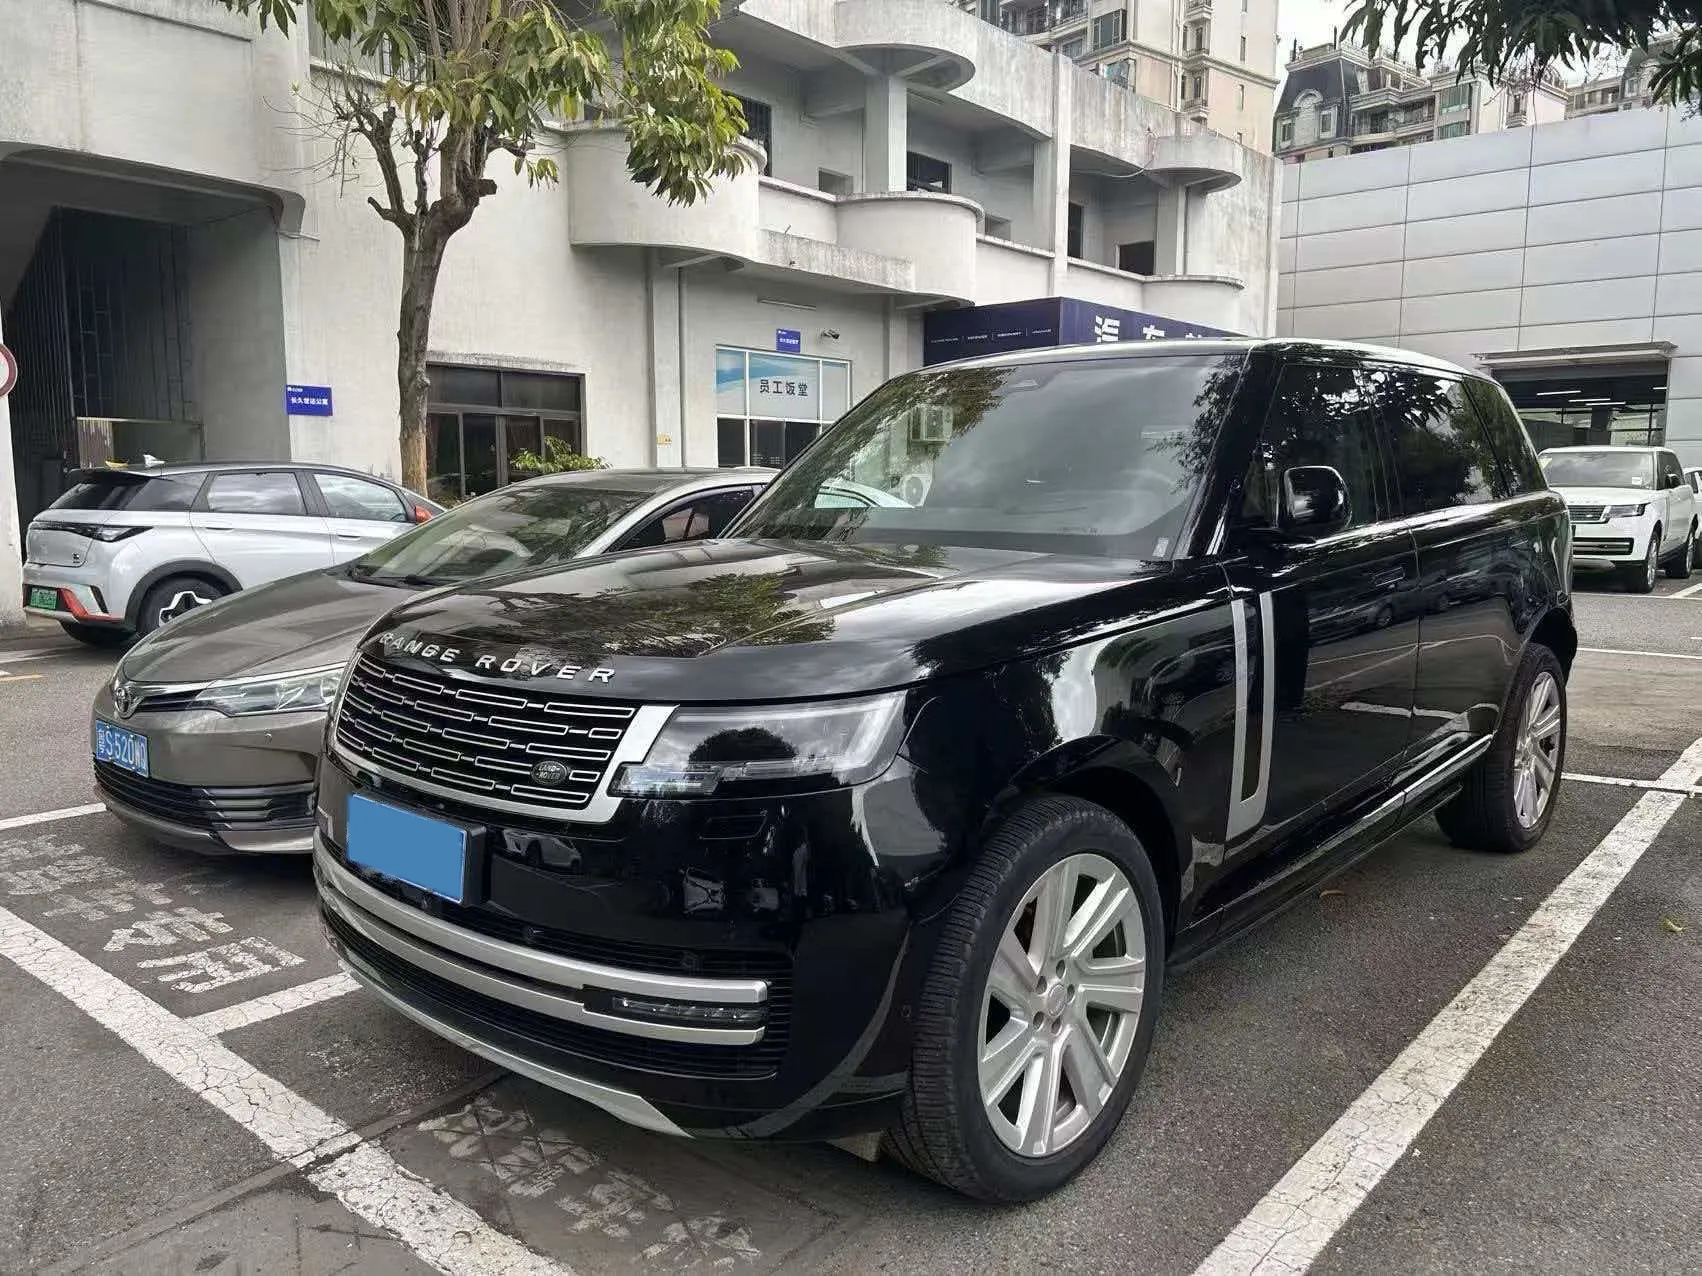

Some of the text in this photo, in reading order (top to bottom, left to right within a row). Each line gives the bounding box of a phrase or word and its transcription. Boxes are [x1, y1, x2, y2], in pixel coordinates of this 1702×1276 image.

[759, 379, 809, 397] 员工饭堂
[379, 632, 616, 683] RANGE ROVER
